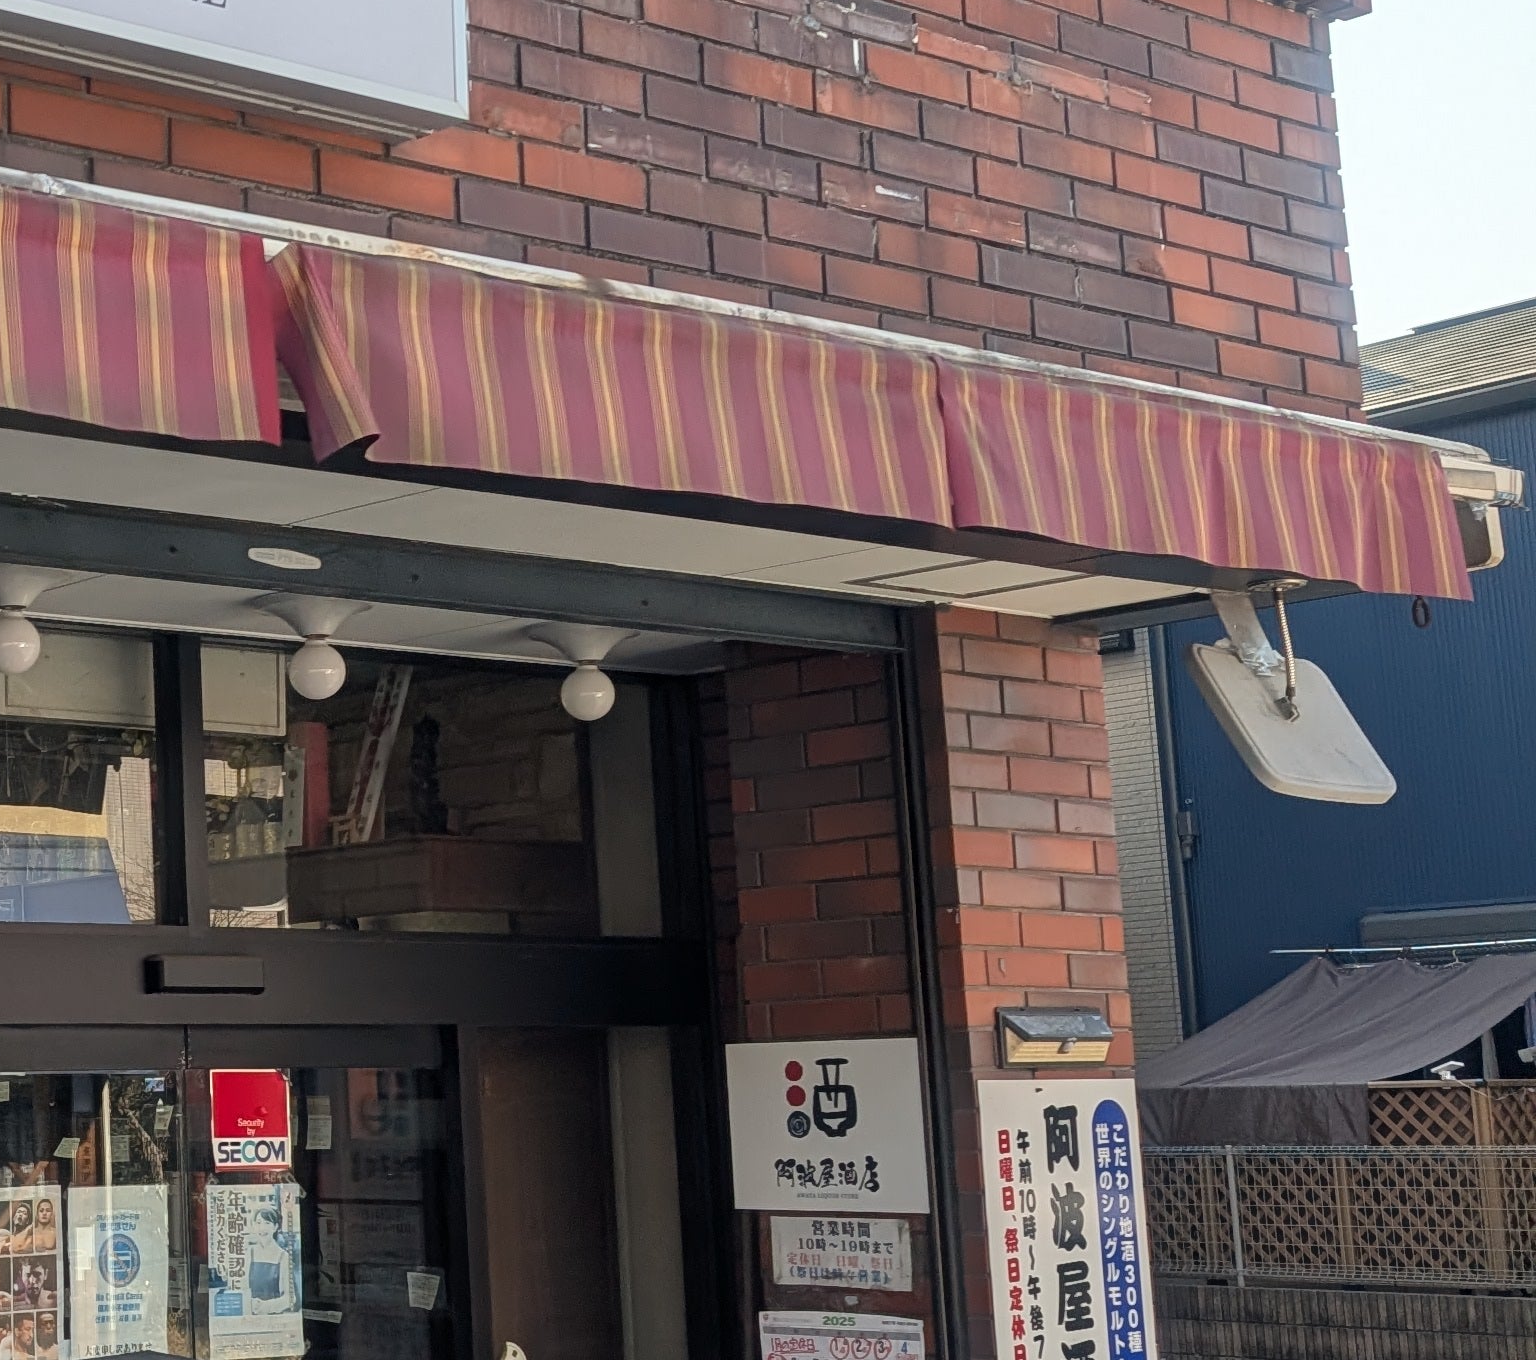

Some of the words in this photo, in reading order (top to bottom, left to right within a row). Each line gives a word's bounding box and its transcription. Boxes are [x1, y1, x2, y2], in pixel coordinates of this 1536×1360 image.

[237, 1118, 265, 1128] Security
[247, 1127, 256, 1136] by
[217, 1140, 286, 1163] SECOM
[774, 1155, 880, 1192] 阿波屋酒店
[811, 1220, 871, 1238] 営業時間
[1112, 1123, 1144, 1353] こだわり地酒300種
[822, 1316, 856, 1327] 2025
